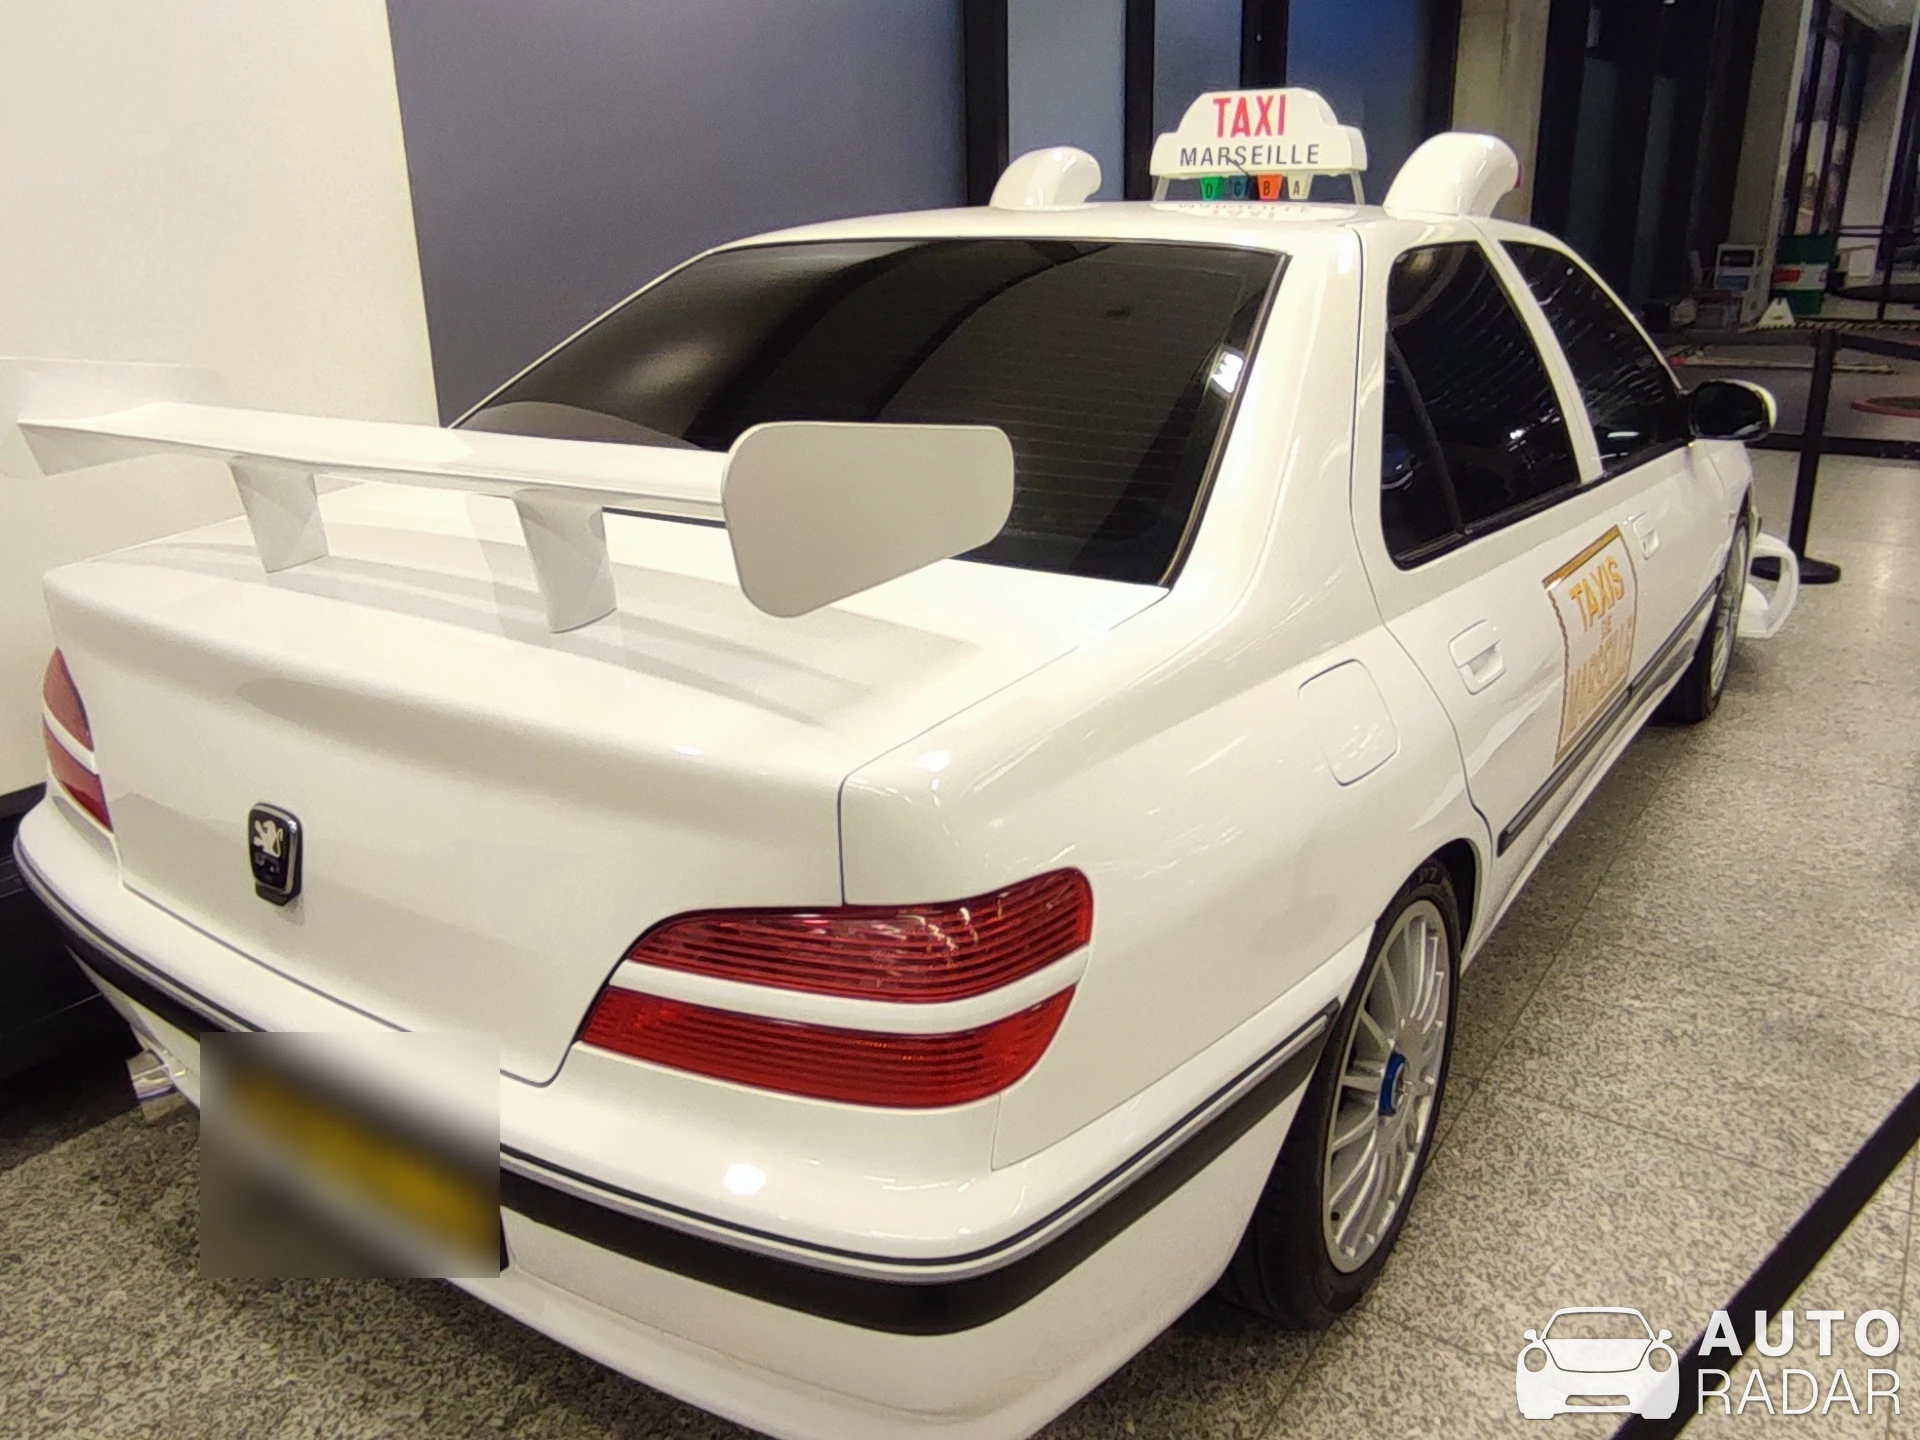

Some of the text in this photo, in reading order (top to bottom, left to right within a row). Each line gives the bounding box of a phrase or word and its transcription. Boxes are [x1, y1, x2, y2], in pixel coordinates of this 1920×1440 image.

[1212, 94, 1287, 138] TAXI
[1179, 144, 1320, 167] MARSEILLE
[1205, 182, 1214, 199] D
[1262, 180, 1272, 197] B
[1292, 180, 1301, 197] A
[1569, 556, 1625, 632] TAXIS
